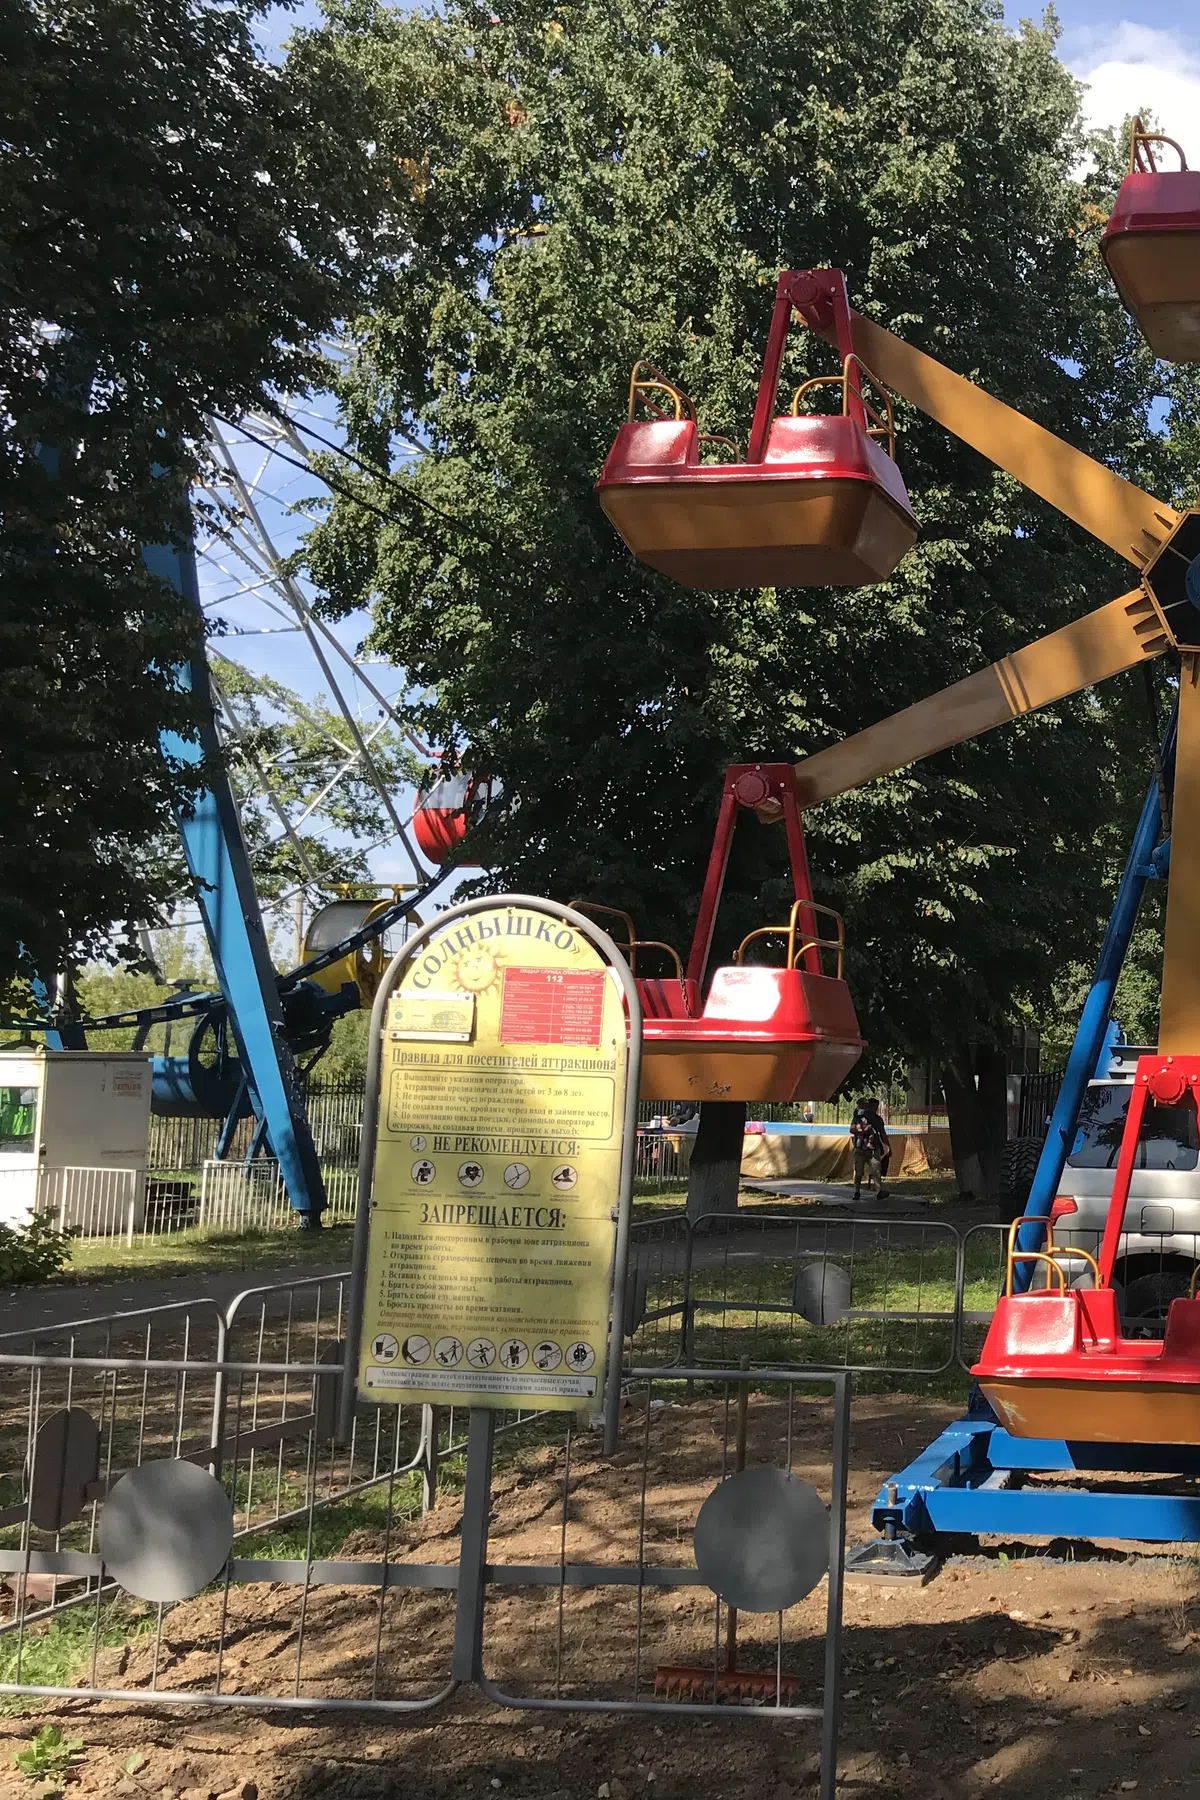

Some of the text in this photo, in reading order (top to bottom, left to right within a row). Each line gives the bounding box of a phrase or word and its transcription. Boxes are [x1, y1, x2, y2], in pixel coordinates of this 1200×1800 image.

[546, 975, 563, 983] 112
[392, 1048, 616, 1072] Правила для посетителей аттракциона
[404, 1073, 448, 1083] Выполняйте
[449, 1076, 484, 1084] указания
[485, 1077, 525, 1086] оператора.
[403, 1083, 446, 1092] Аттракцион
[448, 1086, 498, 1094] предназначен
[516, 1087, 536, 1095] детей
[403, 1092, 412, 1100] Не
[402, 1102, 411, 1110] Не
[470, 1106, 505, 1114] пройдите
[507, 1107, 528, 1115] через
[557, 1119, 595, 1127] оператора
[507, 1126, 542, 1134] пройдите
[434, 1136, 580, 1156] НЕ РЕКОМЕНДУЕТСЯ:
[420, 1203, 566, 1228] ЗАПРЕЩАЕТСЯ:
[392, 1232, 433, 1240] Находиться
[435, 1236, 484, 1244] посторонним
[492, 1236, 521, 1245] рабочей
[425, 1243, 453, 1252] работы.
[390, 1251, 431, 1260] Открывать
[390, 1262, 437, 1270] аттракциона.
[381, 1270, 387, 1278] 3.
[389, 1271, 421, 1280] Вставать
[494, 1276, 521, 1284] работы
[388, 1281, 409, 1290] Брать
[380, 1290, 385, 1298] 5.
[388, 1290, 408, 1300] Брать
[416, 1292, 435, 1300] собой
[387, 1300, 415, 1309] Бросать
[417, 1303, 453, 1311] предметы
[380, 1310, 415, 1320] Оператор
